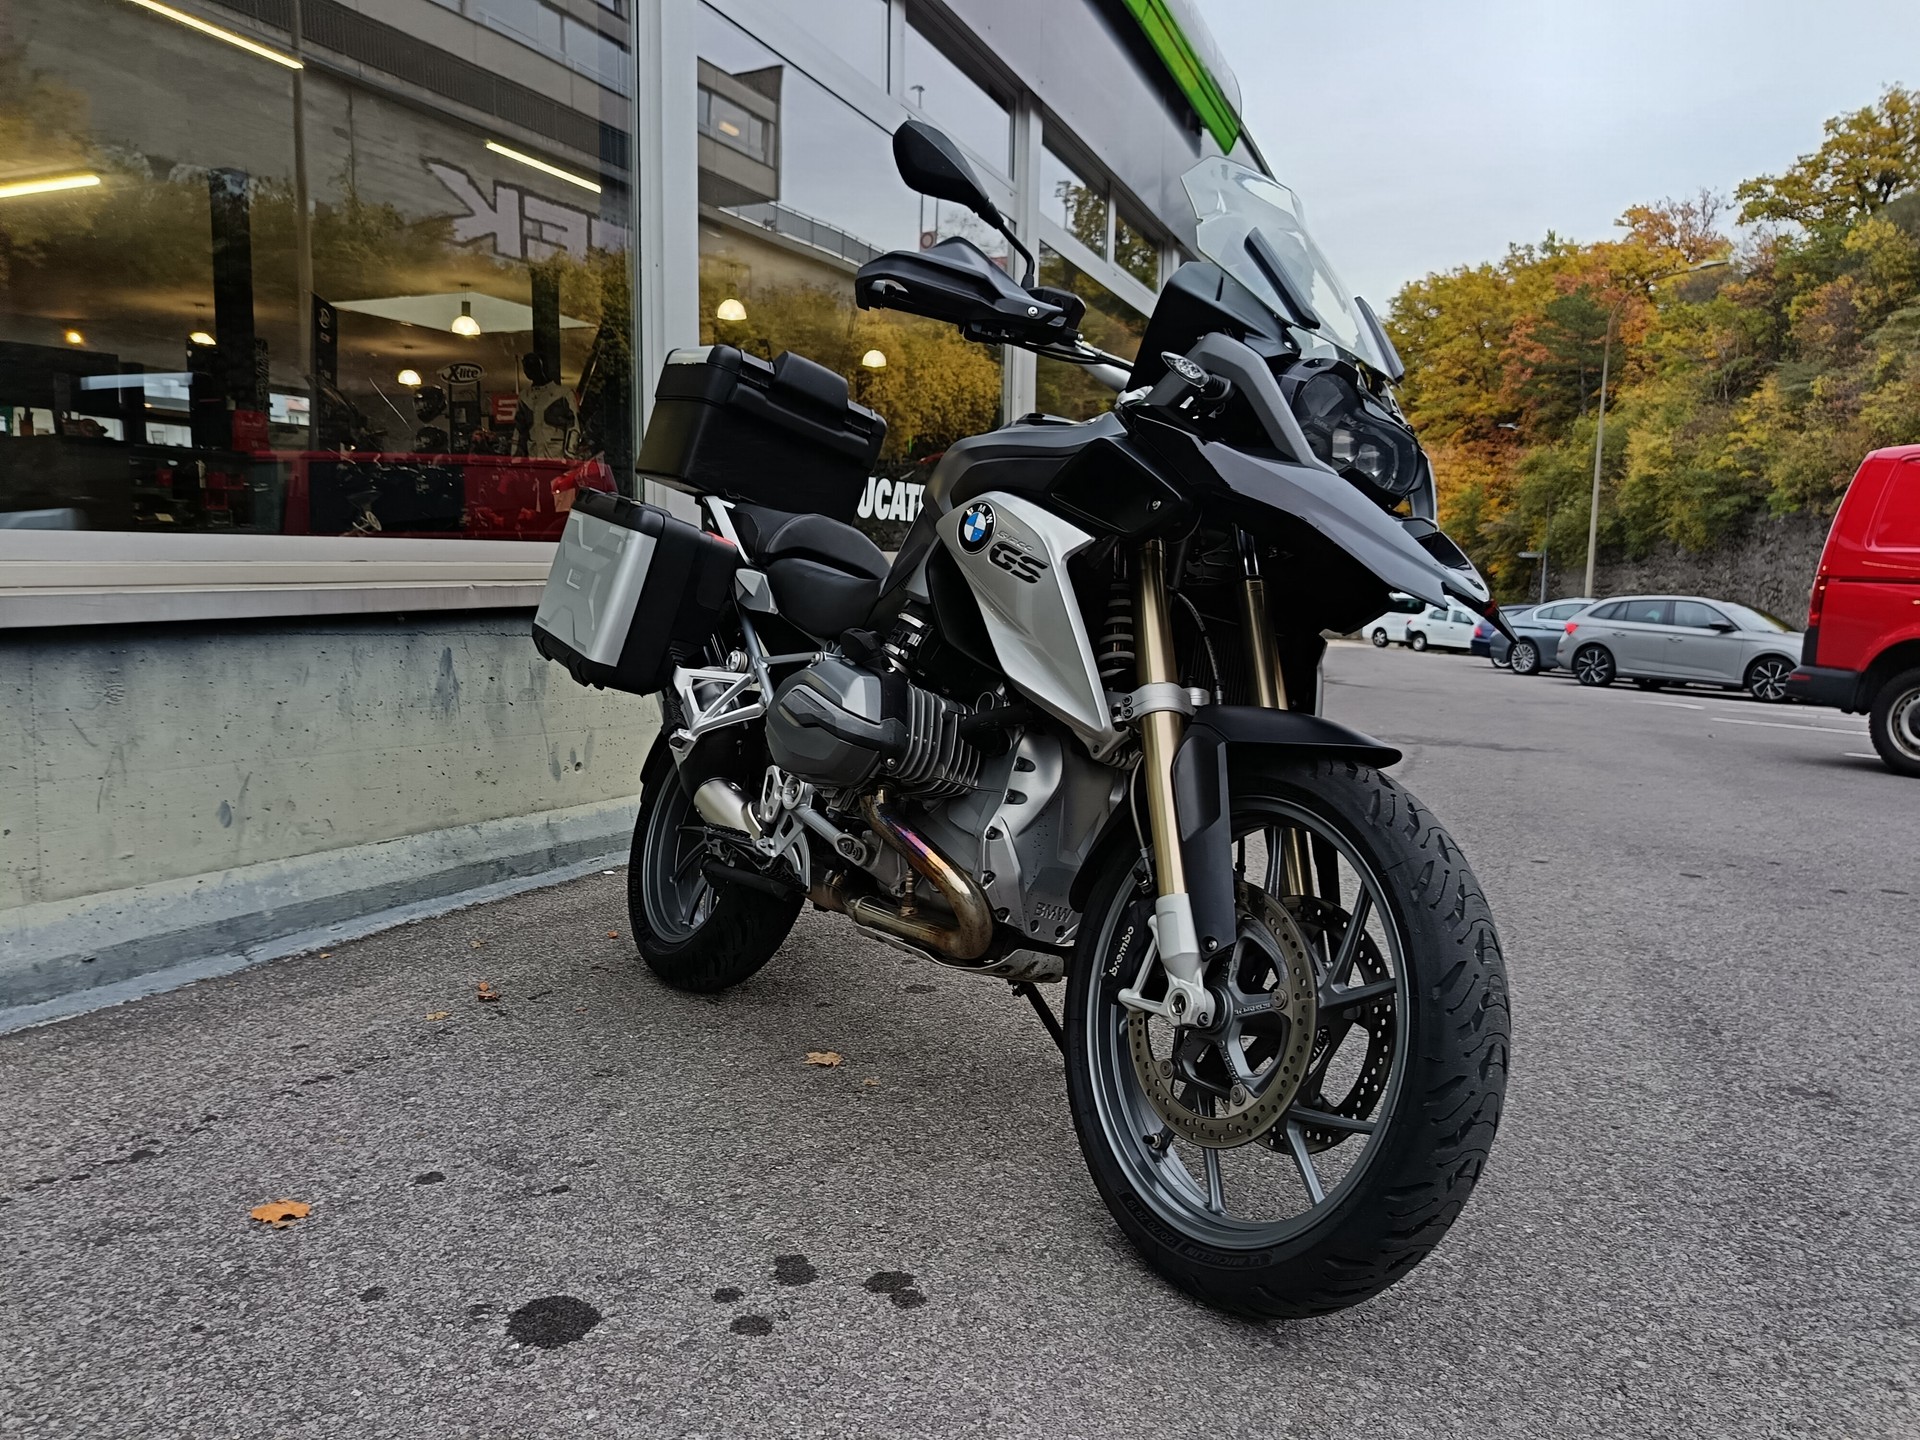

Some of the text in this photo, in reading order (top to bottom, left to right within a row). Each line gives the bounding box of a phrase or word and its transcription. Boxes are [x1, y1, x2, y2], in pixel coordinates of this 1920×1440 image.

[444, 365, 479, 381] X-lite
[966, 504, 993, 524] BMW
[991, 543, 1048, 583] GS
[1035, 902, 1073, 923] BMW
[1108, 926, 1134, 976] brembo
[1185, 1246, 1247, 1267] MICHELIN
